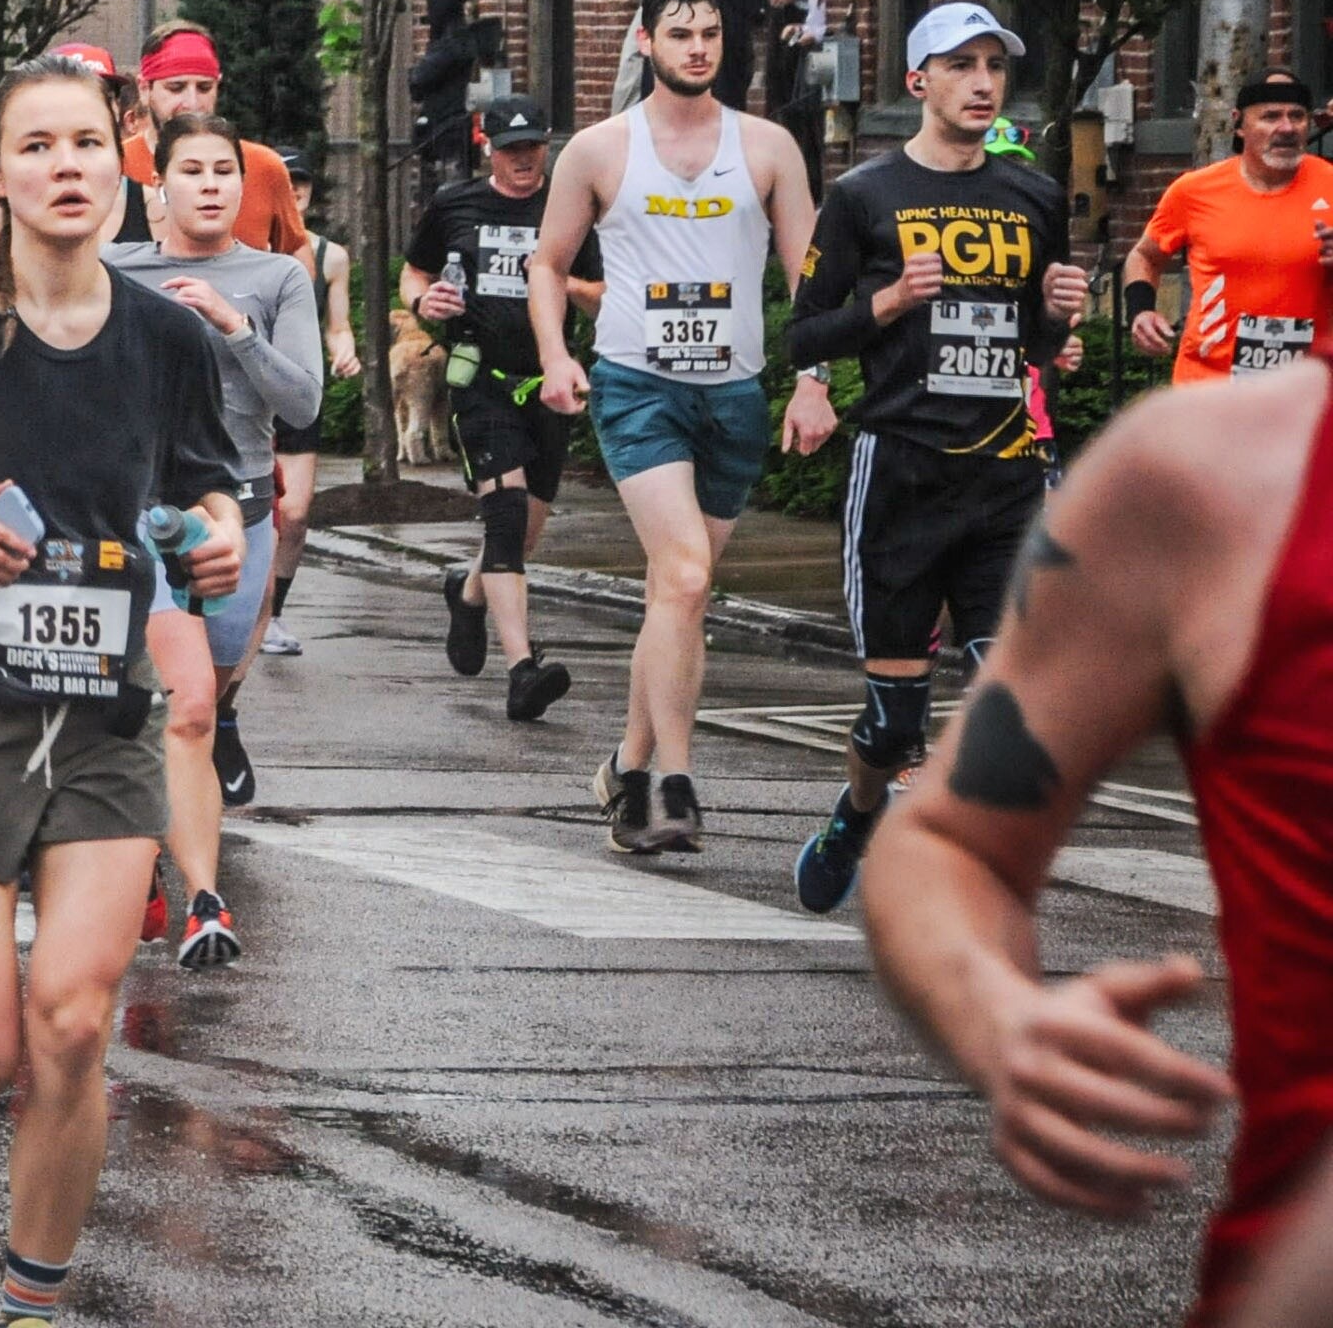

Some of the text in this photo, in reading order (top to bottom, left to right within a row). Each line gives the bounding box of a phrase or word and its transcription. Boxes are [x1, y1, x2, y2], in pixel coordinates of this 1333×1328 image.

[645, 195, 735, 219] MD
[896, 206, 1028, 224] UPMC HEALTH PLAN
[898, 219, 1031, 278] PGH
[489, 254, 523, 276] 211
[662, 320, 718, 343] 3367
[939, 345, 1015, 378] 20673
[18, 603, 101, 648] 1355
[7, 647, 59, 672] DICK'S
